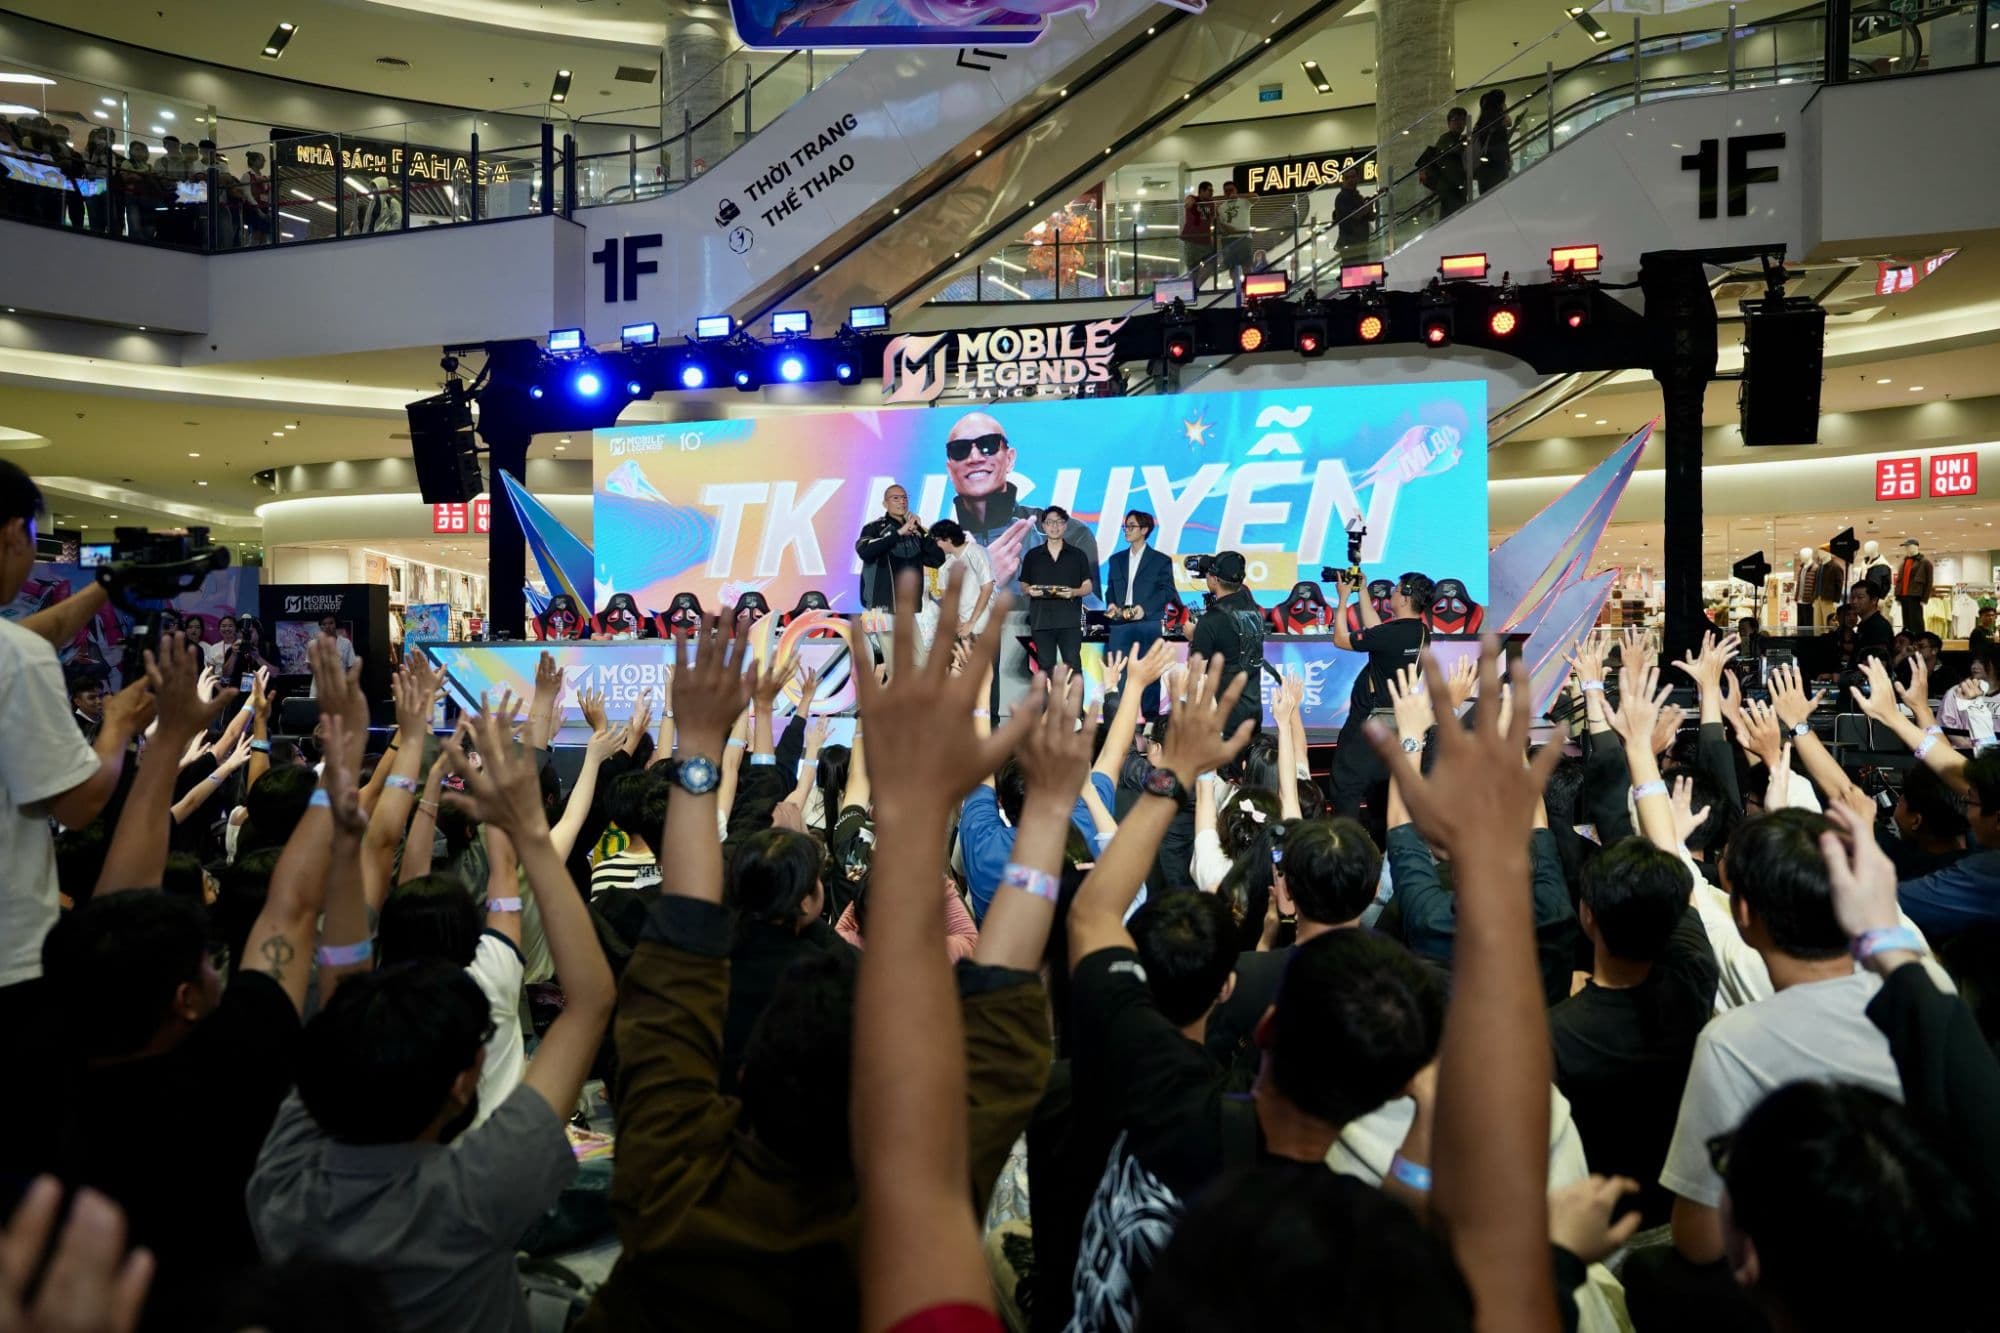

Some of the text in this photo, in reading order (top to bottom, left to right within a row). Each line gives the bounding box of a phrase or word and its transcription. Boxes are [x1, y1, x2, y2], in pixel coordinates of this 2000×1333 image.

[297, 144, 334, 166] NHÀ
[342, 148, 386, 173] SÁCH
[744, 113, 858, 202] THỜI TRANG
[761, 154, 854, 227] THỂ THAO
[1681, 131, 1786, 219] 1F
[592, 233, 663, 303] 1F
[956, 315, 1131, 363] MOBILE
[955, 352, 1116, 390] LEGENDS
[968, 384, 1097, 400] BANG BANG
[1935, 458, 1969, 475] UNI
[1935, 475, 1972, 494] QLO
[702, 477, 846, 579] TK
[303, 594, 344, 604] MOBILE
[599, 663, 665, 684] MOBI
[599, 685, 665, 701] LEGEN
